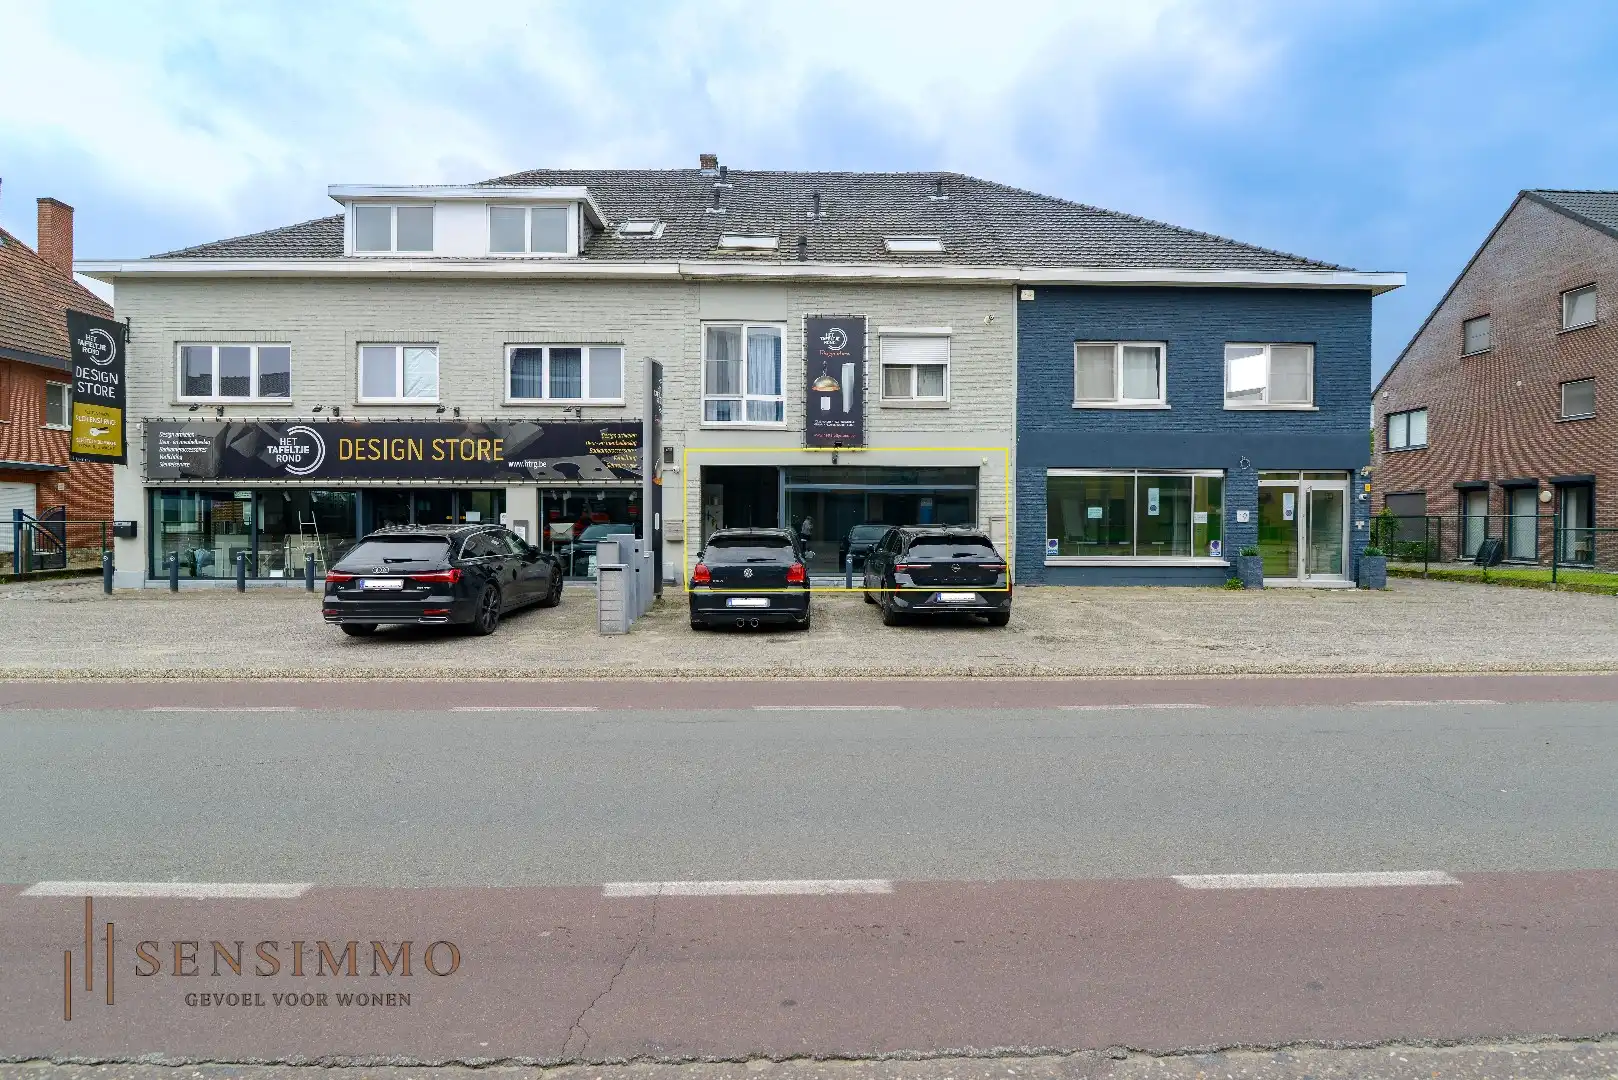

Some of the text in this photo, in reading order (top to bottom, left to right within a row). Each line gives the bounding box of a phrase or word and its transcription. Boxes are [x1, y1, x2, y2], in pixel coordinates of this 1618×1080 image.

[75, 366, 119, 385] DESIGN
[77, 381, 116, 399] STORE
[279, 437, 297, 446] HET
[267, 446, 310, 454] TAFELTJE
[339, 438, 504, 461] DESIGN STORE
[276, 454, 301, 463] ROND
